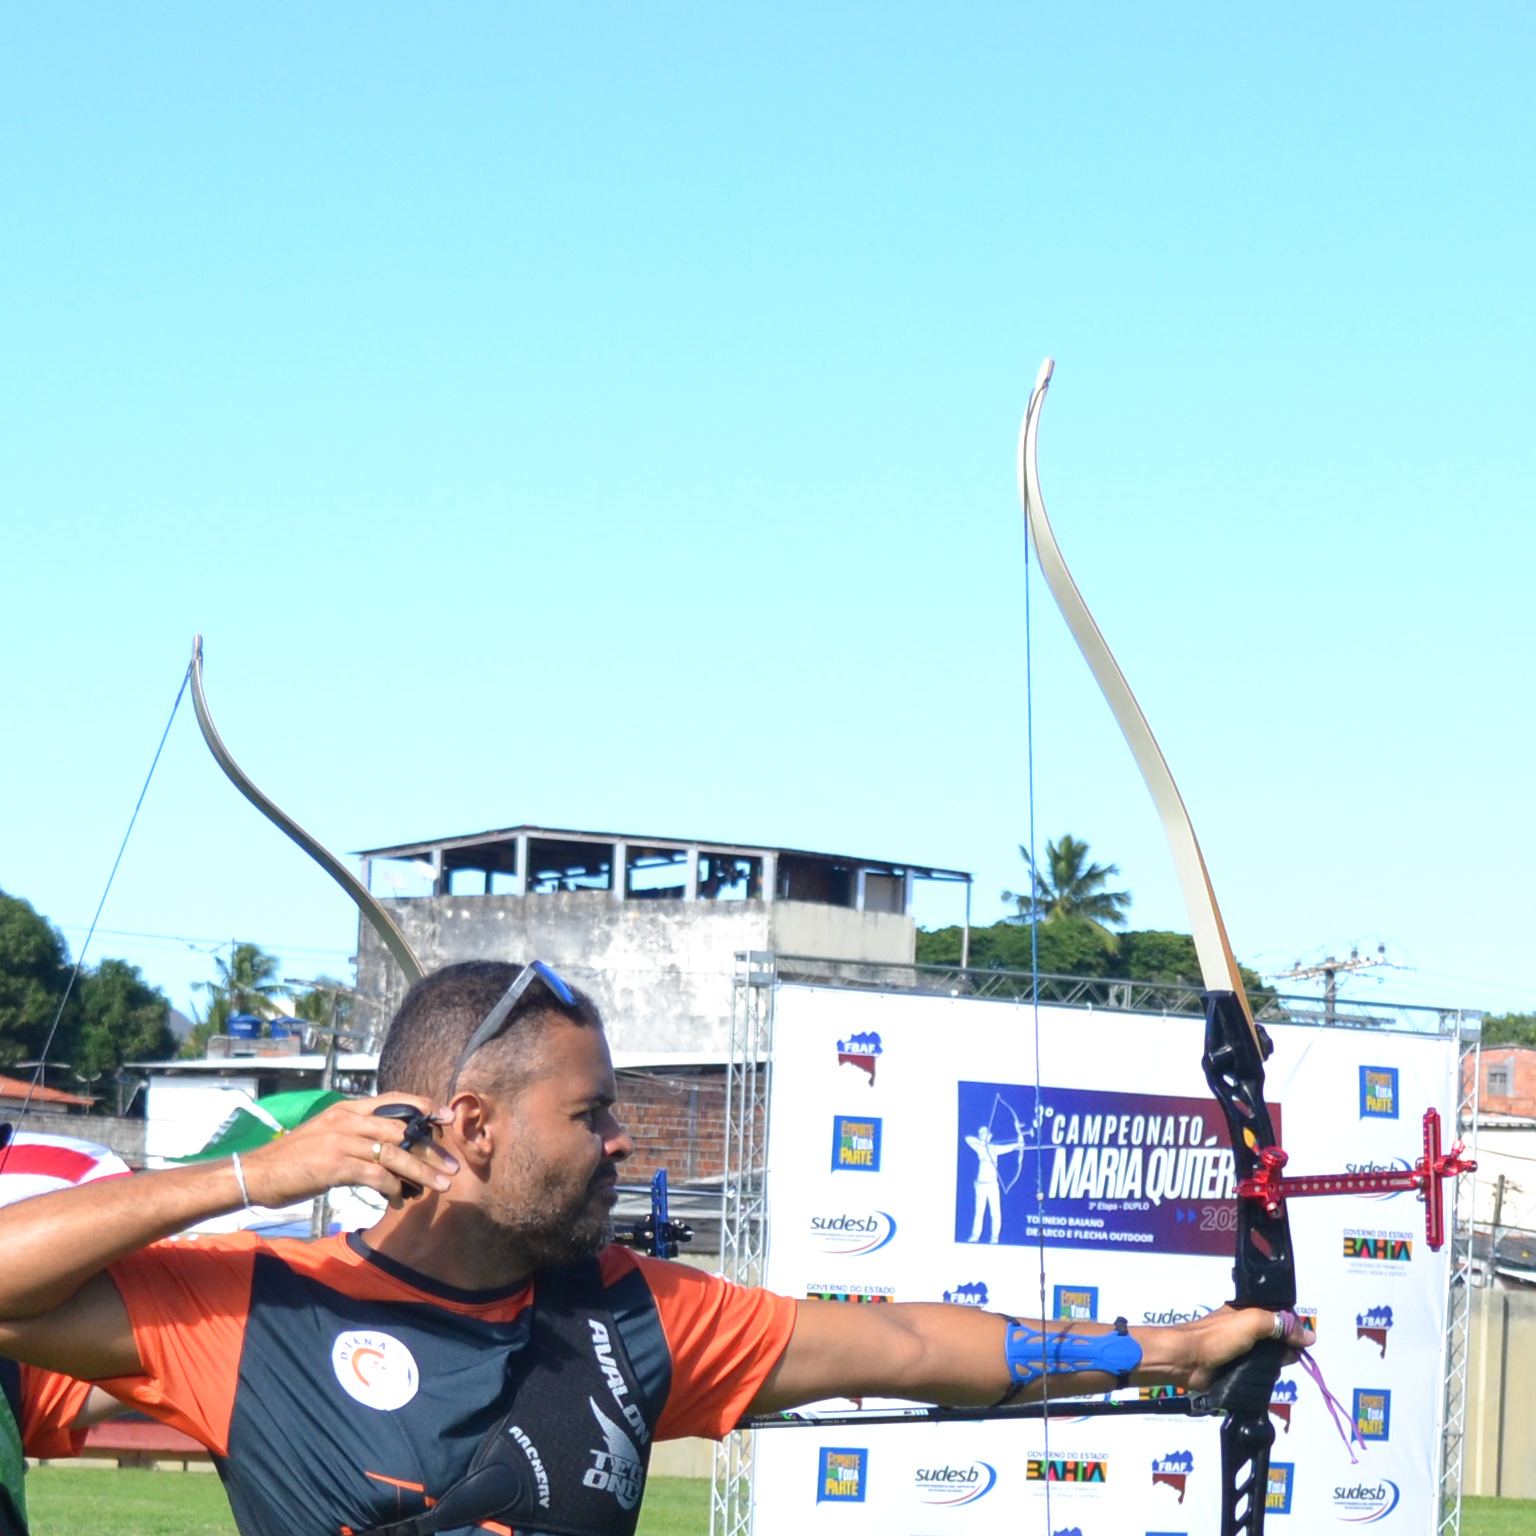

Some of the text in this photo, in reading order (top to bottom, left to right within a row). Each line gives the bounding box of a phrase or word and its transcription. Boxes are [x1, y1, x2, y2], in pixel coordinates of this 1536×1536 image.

[844, 1042, 876, 1054] FBAF
[1051, 1114, 1203, 1145] CAMPEONATO
[1049, 1147, 1146, 1199] MARIA
[1123, 1202, 1150, 1211] DUPLO
[810, 1214, 878, 1232] sudesb
[1068, 1218, 1104, 1228] BAIANO
[1026, 1227, 1154, 1243] DE ARCO E FLECHA OUTDOOR
[1377, 1230, 1387, 1238] DO
[1389, 1231, 1413, 1239] ESTADO
[807, 1283, 896, 1295] GOVERNO DO ESTADO
[950, 1293, 982, 1304] FBAF
[1362, 1316, 1388, 1328] FBAF
[340, 1337, 386, 1360] DIANA
[588, 1318, 650, 1445] AVALON
[1270, 1391, 1292, 1402] BAF
[1080, 1452, 1109, 1460] ESTADO
[508, 1426, 551, 1509] ARCHERY
[1158, 1461, 1188, 1472] FBAF
[914, 1465, 979, 1483] sudesb
[1333, 1483, 1386, 1500] sudesb
